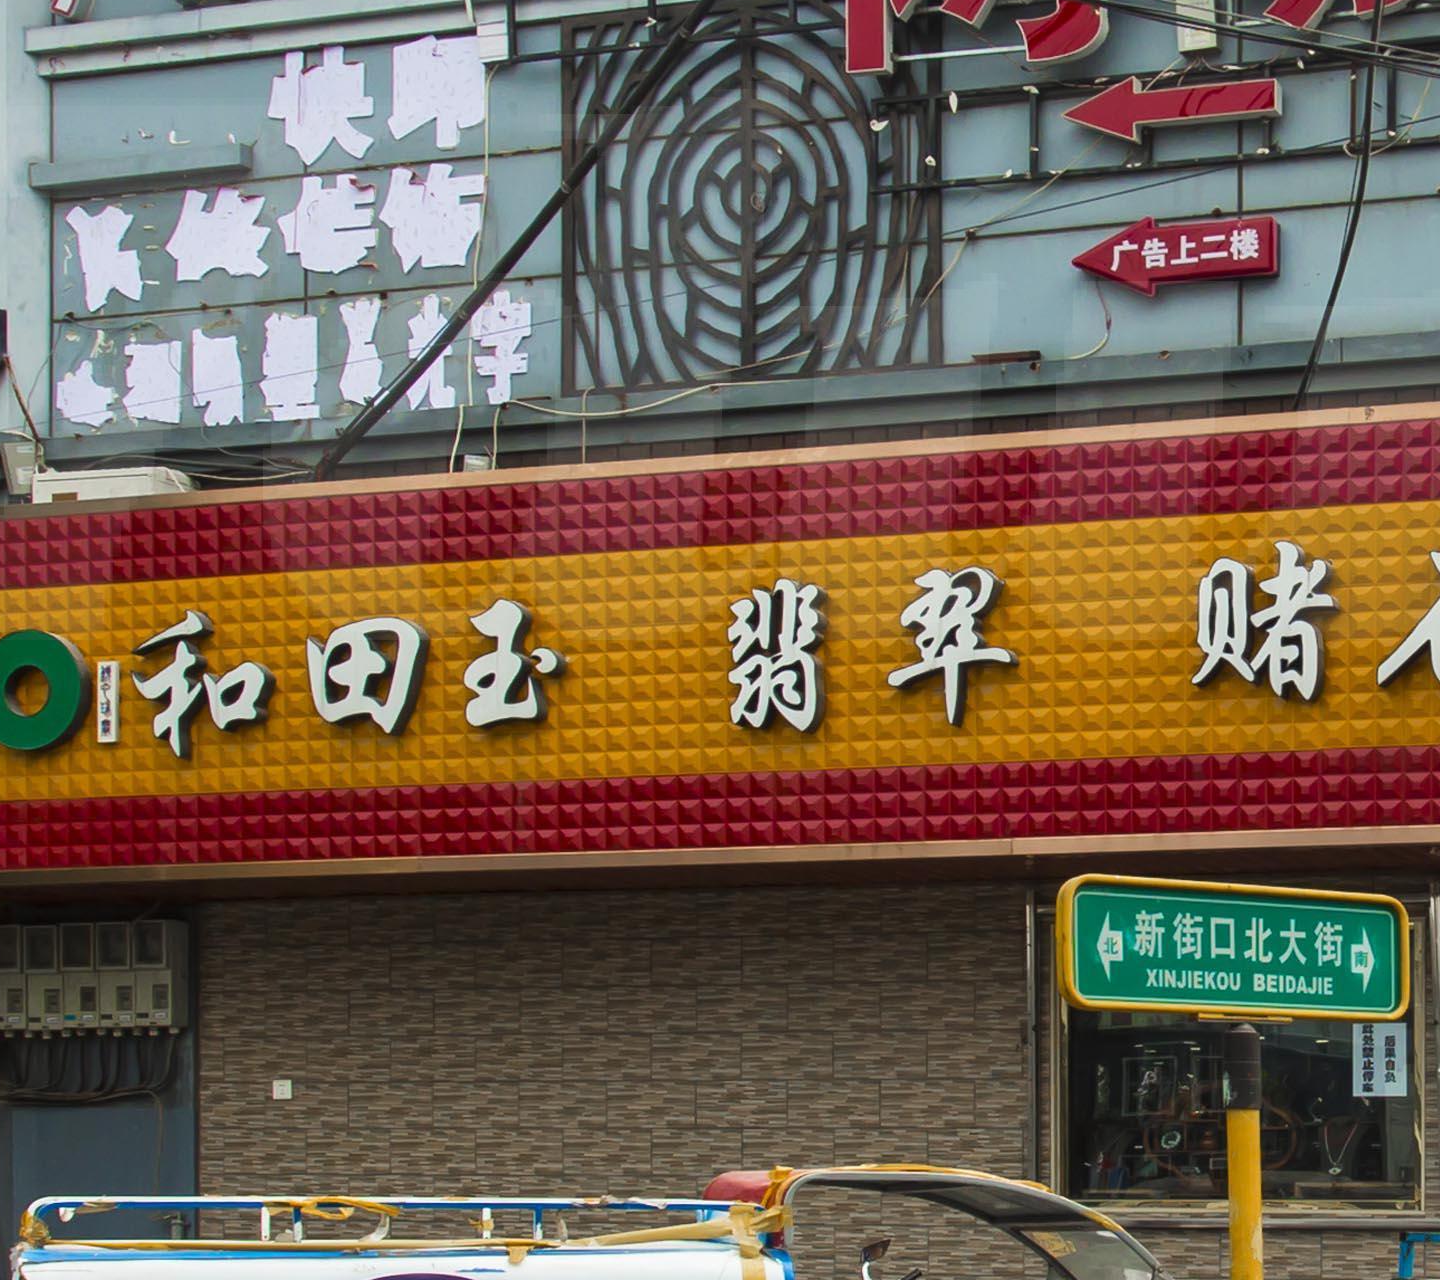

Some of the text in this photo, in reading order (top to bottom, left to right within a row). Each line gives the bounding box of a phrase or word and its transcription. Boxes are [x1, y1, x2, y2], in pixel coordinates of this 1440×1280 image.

[1110, 228, 1260, 273] 广告上二楼
[130, 597, 569, 761] 和田玉
[726, 565, 1018, 733] 翡翠
[1133, 910, 1344, 969] 新街口北大街
[1145, 967, 1334, 997] XINJIEKOU BEIDAJIE
